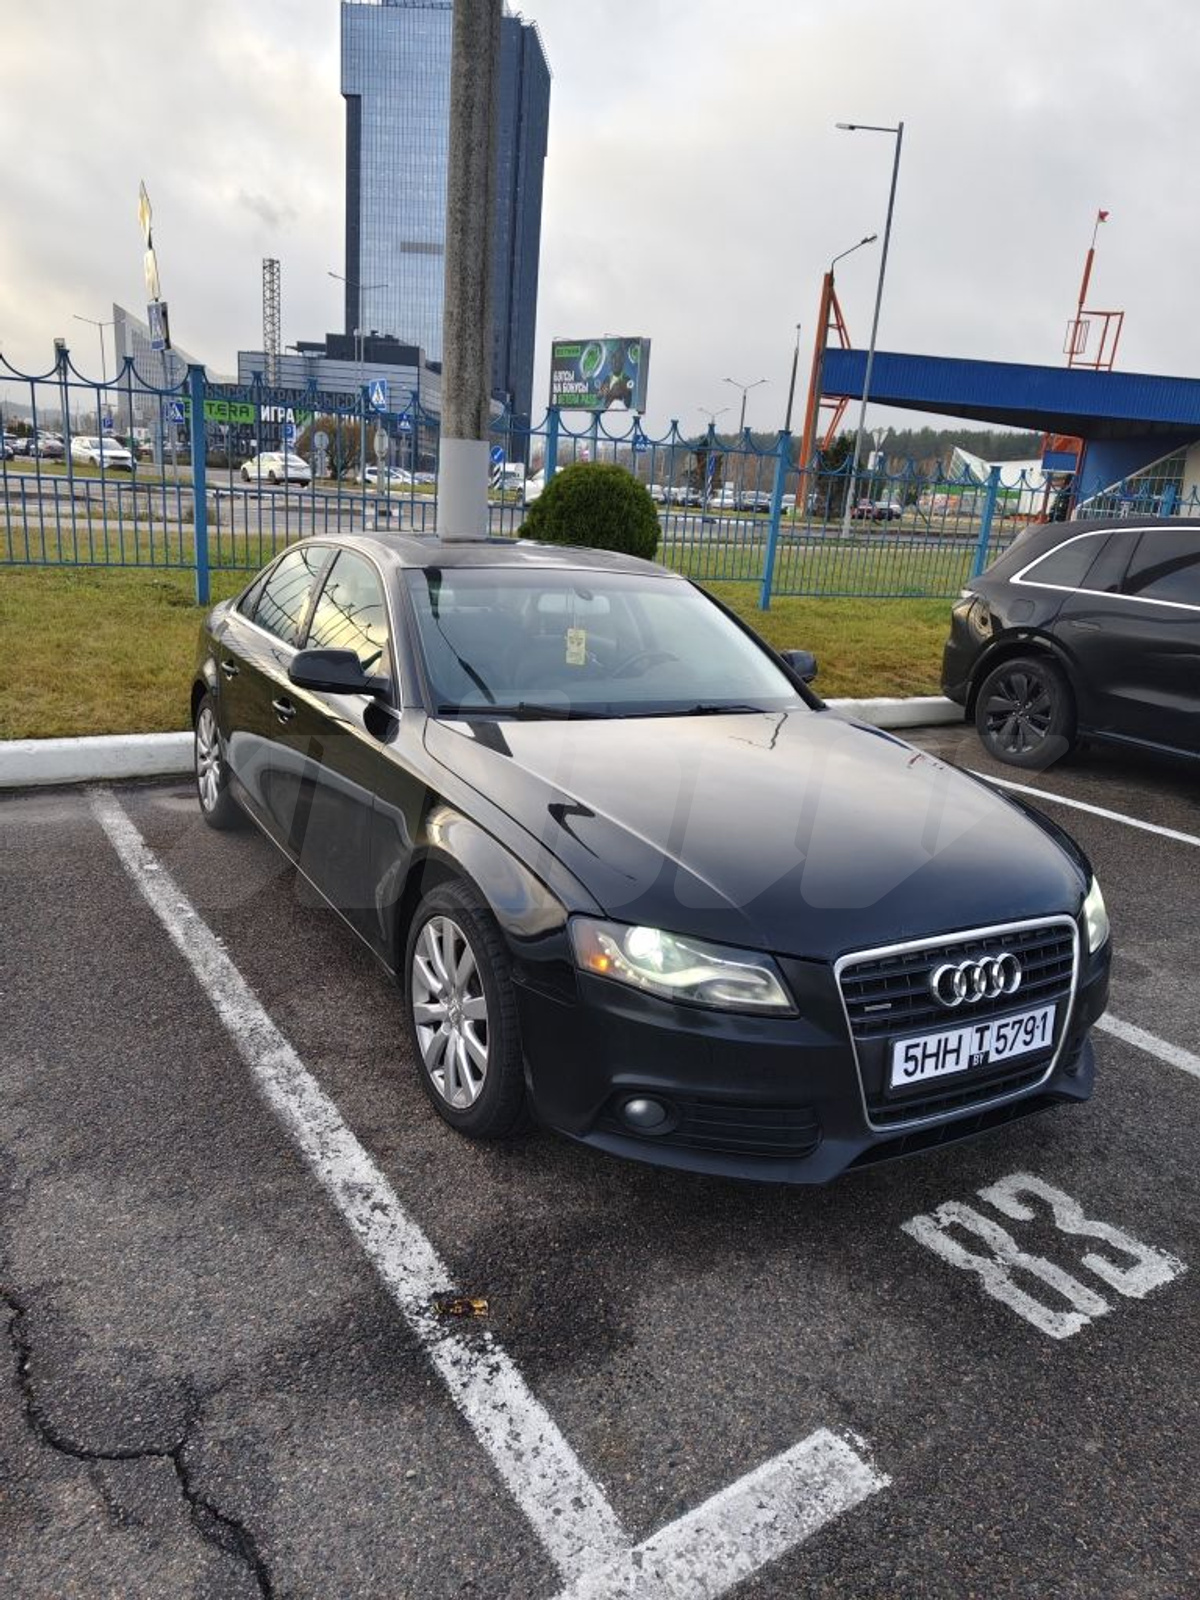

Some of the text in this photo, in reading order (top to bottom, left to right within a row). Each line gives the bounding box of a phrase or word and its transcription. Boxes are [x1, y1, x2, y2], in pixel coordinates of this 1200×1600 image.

[261, 404, 295, 423] ИГРА
[903, 1034, 963, 1077] 5HH
[975, 1025, 990, 1051] T
[973, 1053, 985, 1065] BY
[901, 1172, 1188, 1340] 83
